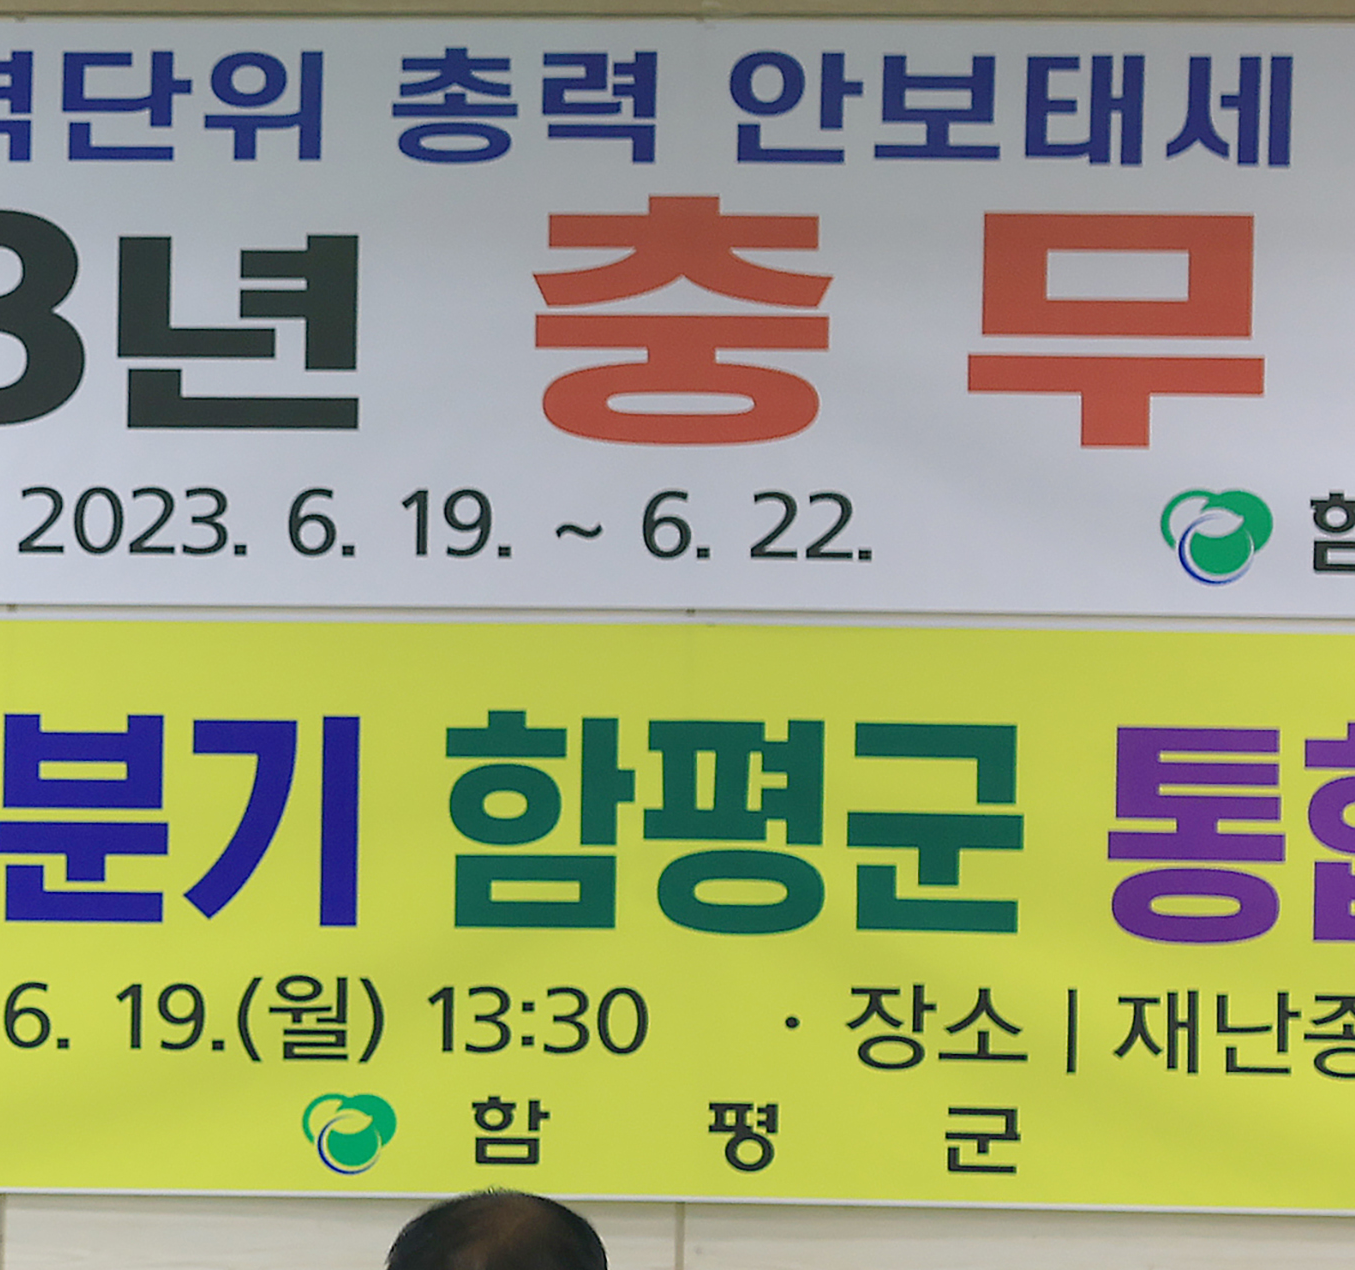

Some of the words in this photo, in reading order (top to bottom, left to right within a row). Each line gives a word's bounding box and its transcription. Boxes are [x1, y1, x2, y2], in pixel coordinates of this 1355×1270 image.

[392, 47, 657, 163] 총력
[730, 51, 1293, 167] 안보태세
[18, 486, 247, 556] 2023.
[288, 487, 355, 557] 6.
[402, 489, 511, 558] 19.
[642, 491, 710, 559] 6.
[750, 491, 872, 561] 22.
[445, 710, 1024, 936] 함평군
[1108, 722, 1355, 943] 통
[4, 981, 70, 1050] 6.
[116, 974, 384, 1064] 19.(월)
[427, 985, 650, 1056] 13:30
[845, 983, 1028, 1071] 장소
